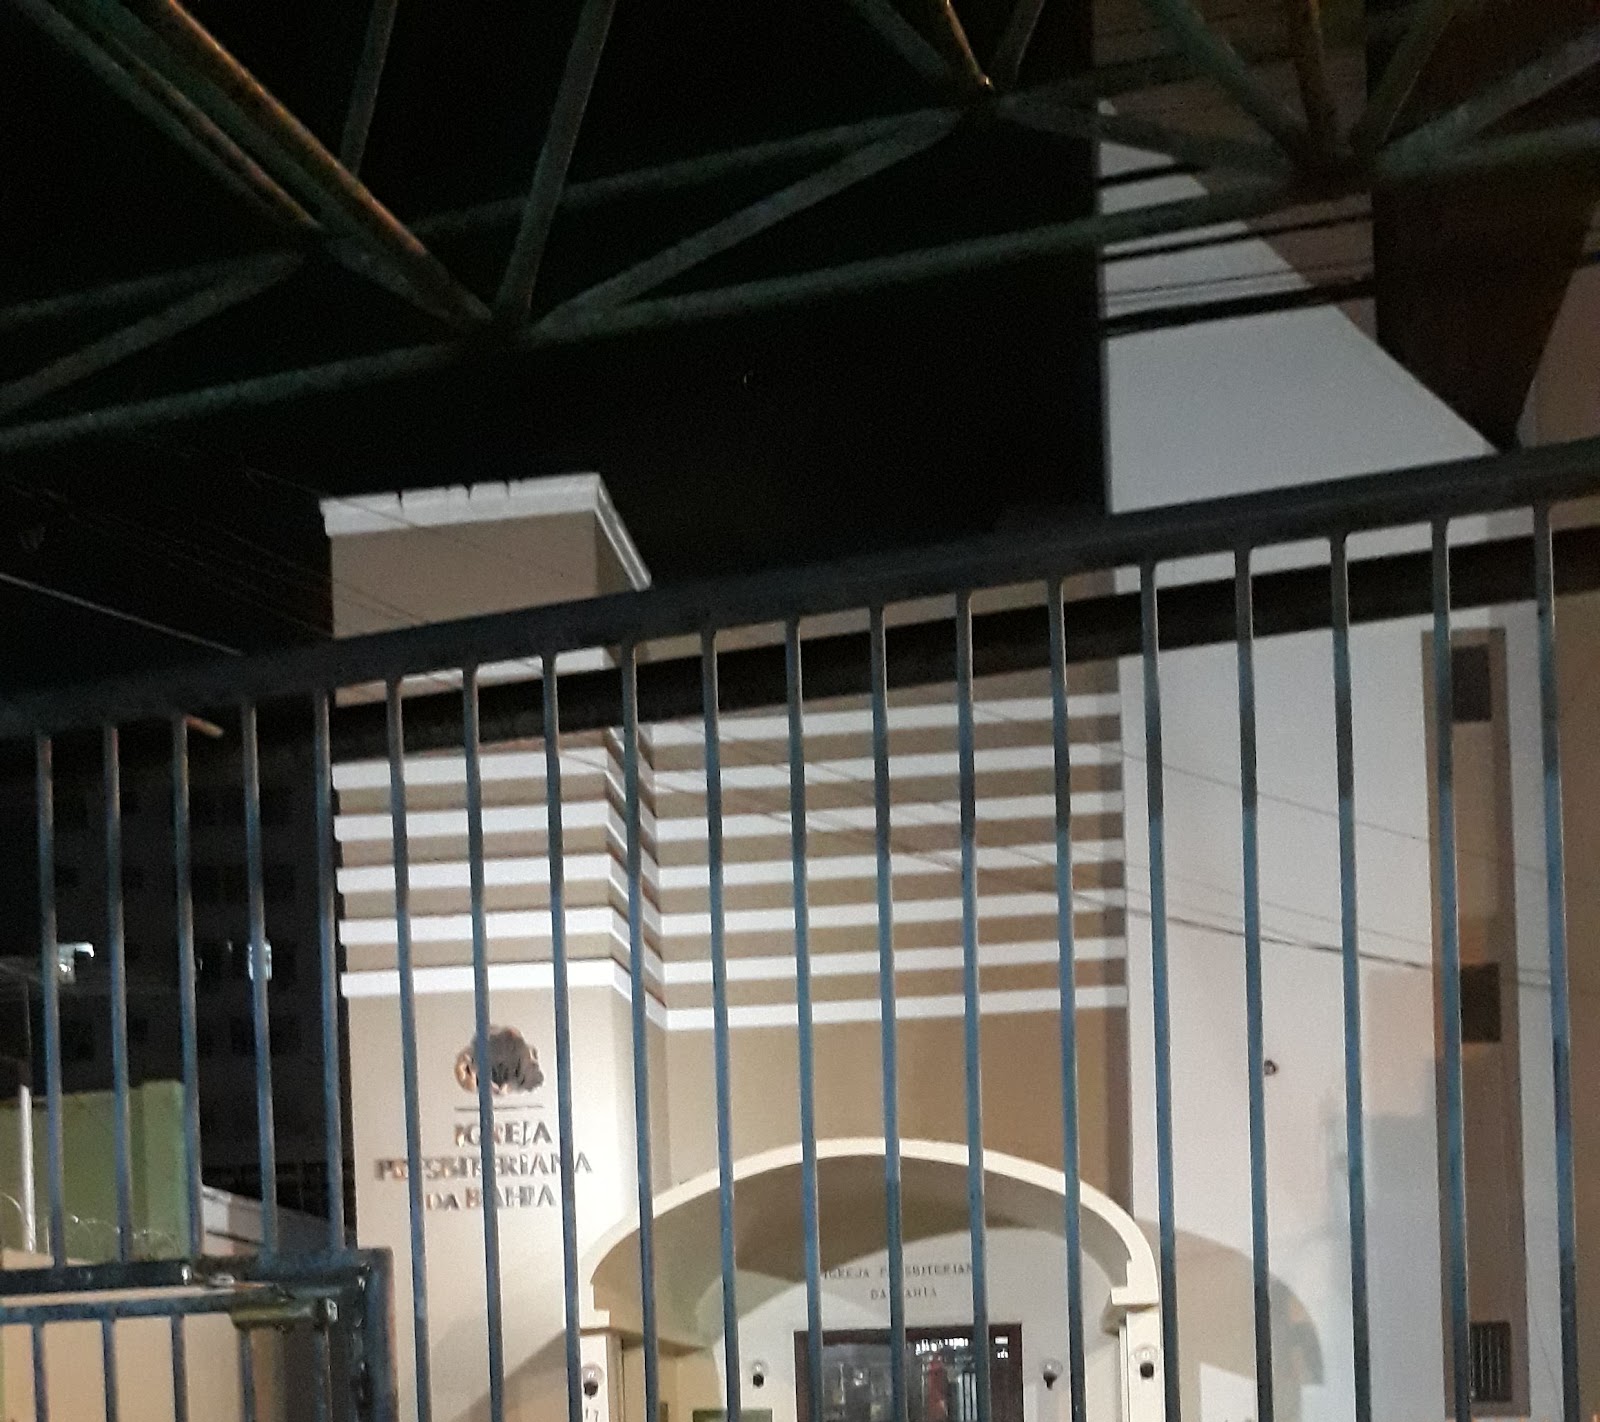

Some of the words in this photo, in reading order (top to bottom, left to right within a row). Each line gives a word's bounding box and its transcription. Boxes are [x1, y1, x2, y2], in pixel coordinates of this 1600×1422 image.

[454, 1120, 553, 1147] IGREJA
[375, 1151, 593, 1182] PRSBITRIANA
[426, 1193, 460, 1211] DA
